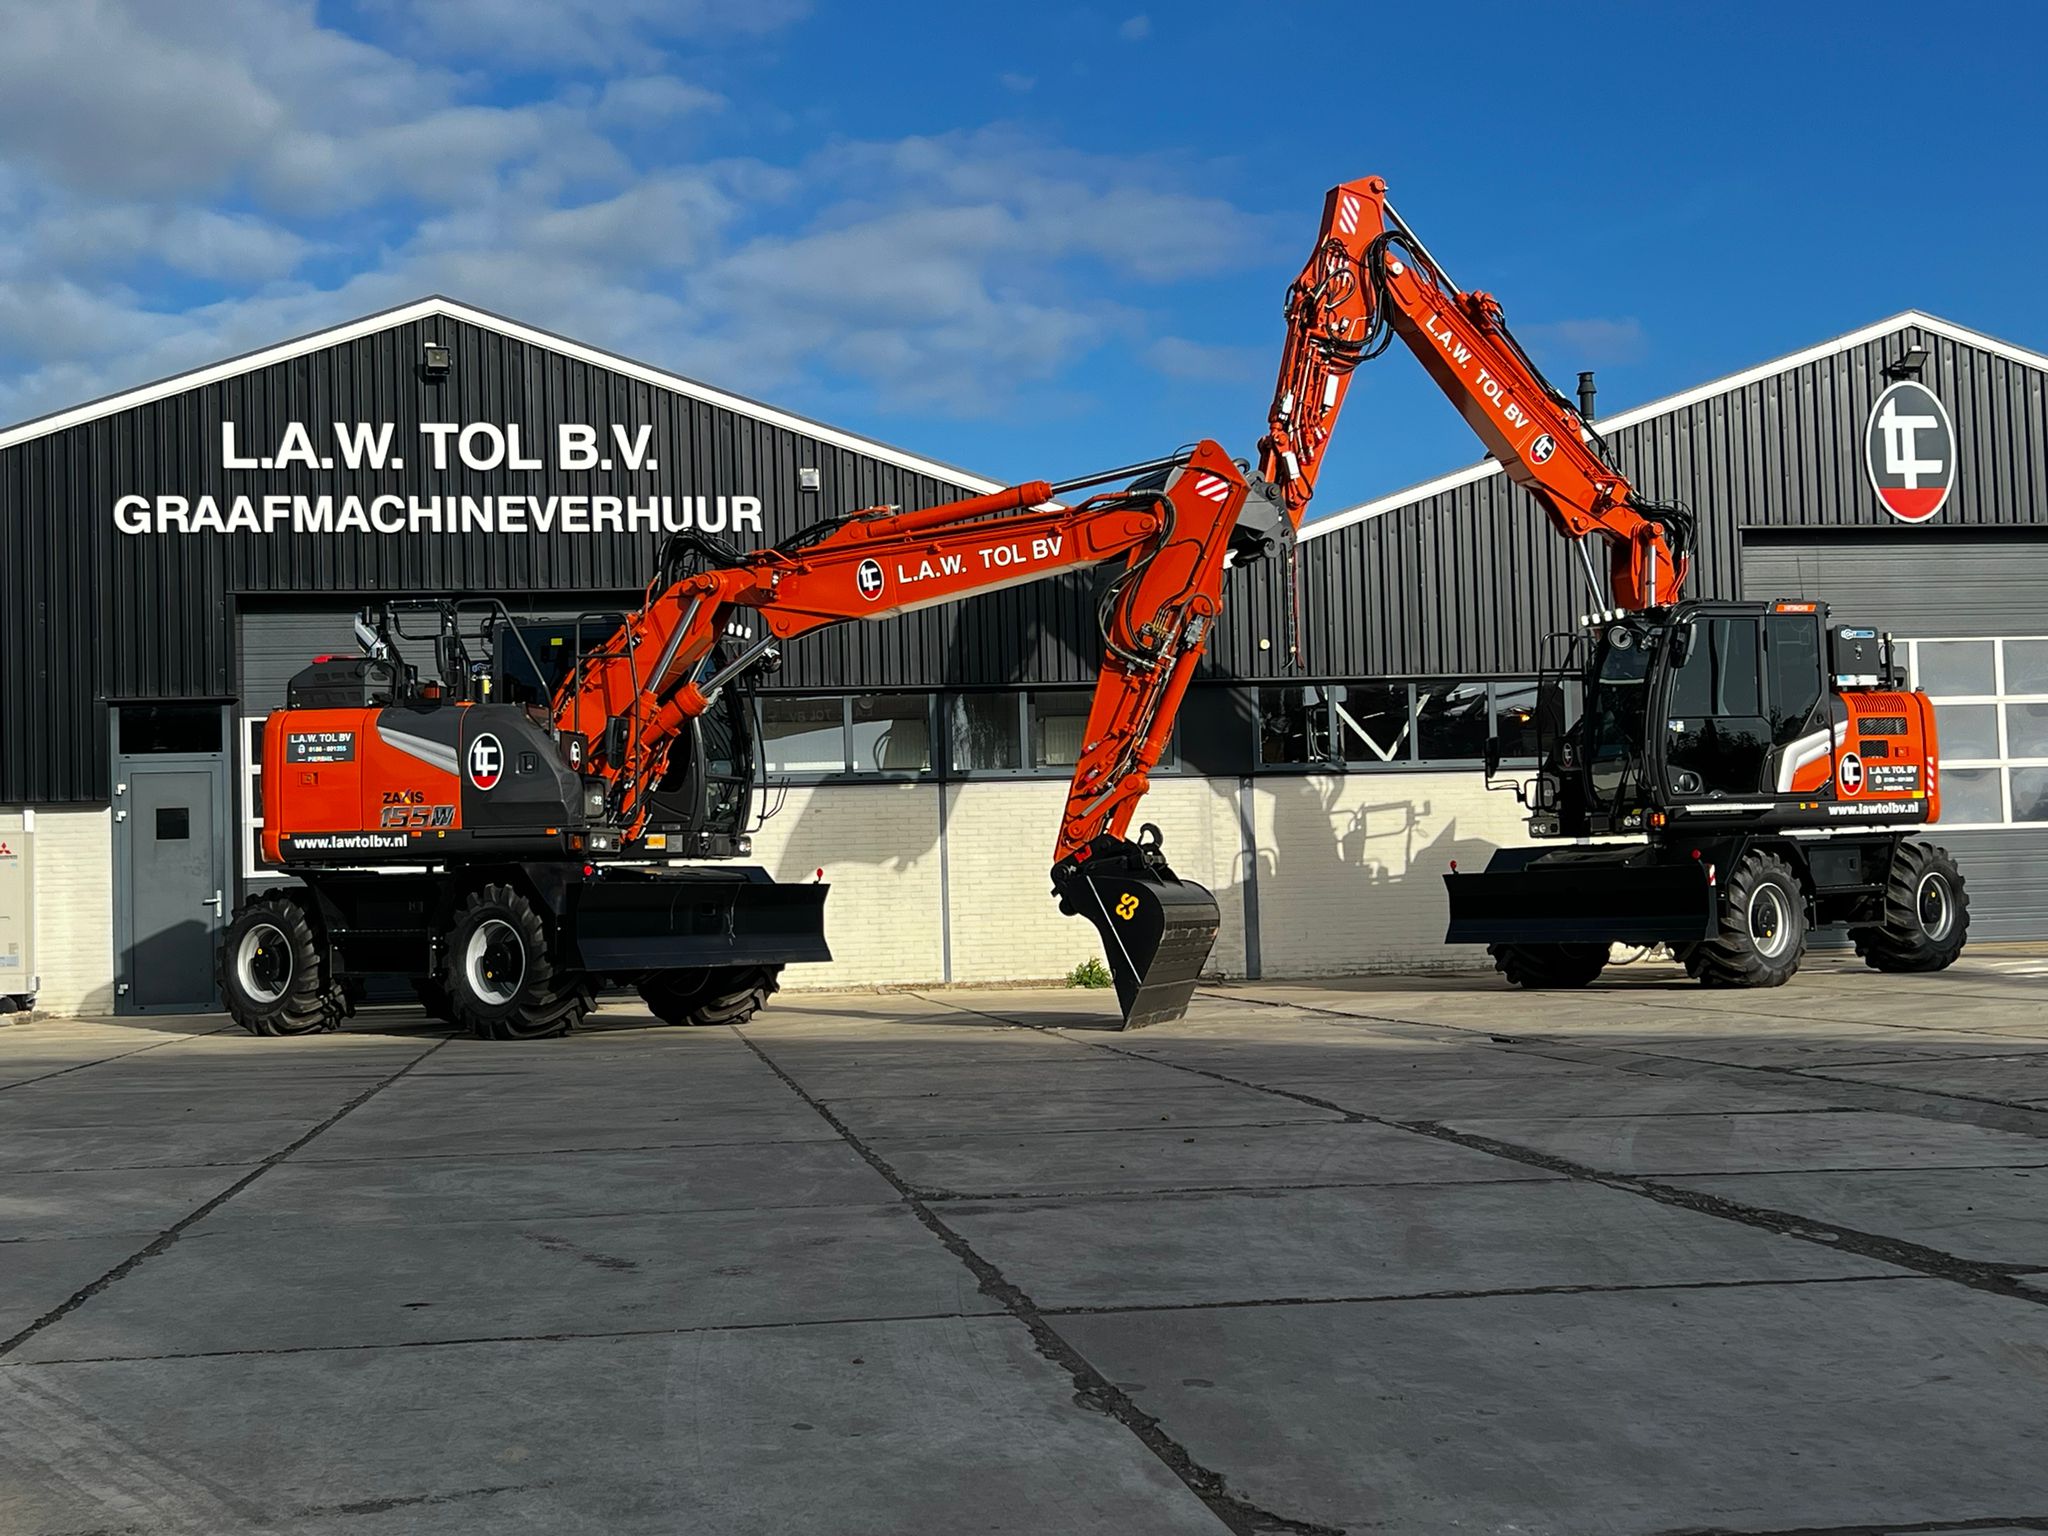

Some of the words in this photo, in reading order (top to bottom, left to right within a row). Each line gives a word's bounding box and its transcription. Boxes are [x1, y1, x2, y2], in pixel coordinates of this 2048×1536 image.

[1425, 315, 1471, 369] L.A.W.
[1475, 369, 1506, 409] TOL
[1503, 402, 1530, 429] BV
[222, 421, 404, 470] L.A.W.
[419, 422, 543, 471] TOL
[559, 423, 658, 471] B.V.
[113, 494, 763, 535] GRAAFMACHINEVERHUUR
[897, 554, 967, 584] L.A.W.
[979, 544, 1026, 569] TOL
[1032, 535, 1063, 560] BV
[291, 734, 318, 743] L.A.W.
[319, 733, 338, 742] TOL
[338, 732, 352, 742] BV
[1891, 765, 1906, 774] TOL
[1906, 765, 1917, 774] BV
[382, 788, 425, 804] ZAXIS
[381, 805, 456, 828] 155W
[1828, 802, 1919, 816] www.lawtolbv.nl
[294, 834, 408, 850] www.lawtolbv.nl
